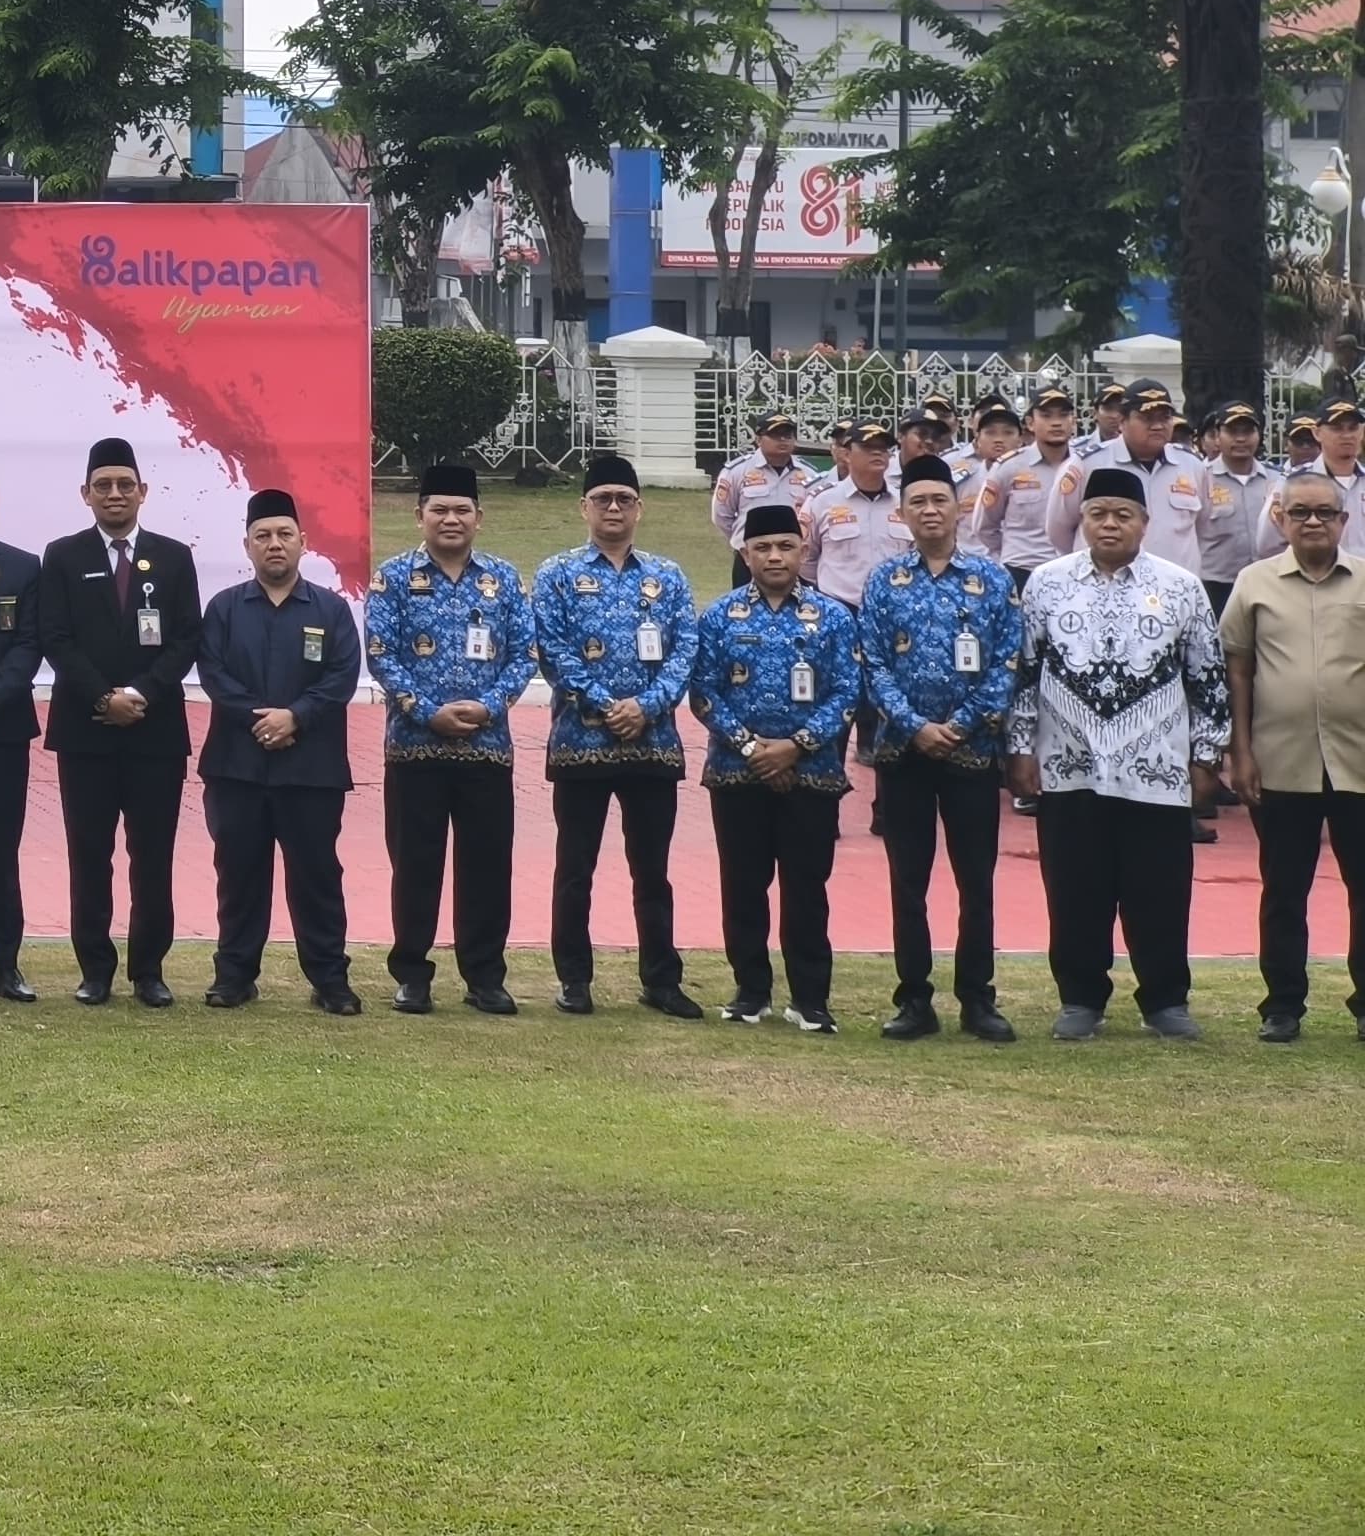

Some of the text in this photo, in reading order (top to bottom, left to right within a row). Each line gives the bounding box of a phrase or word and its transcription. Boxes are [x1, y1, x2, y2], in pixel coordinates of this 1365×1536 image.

[725, 198, 785, 212] EPULIK
[81, 235, 320, 296] Balikpapan
[162, 295, 302, 334] Nyaman
